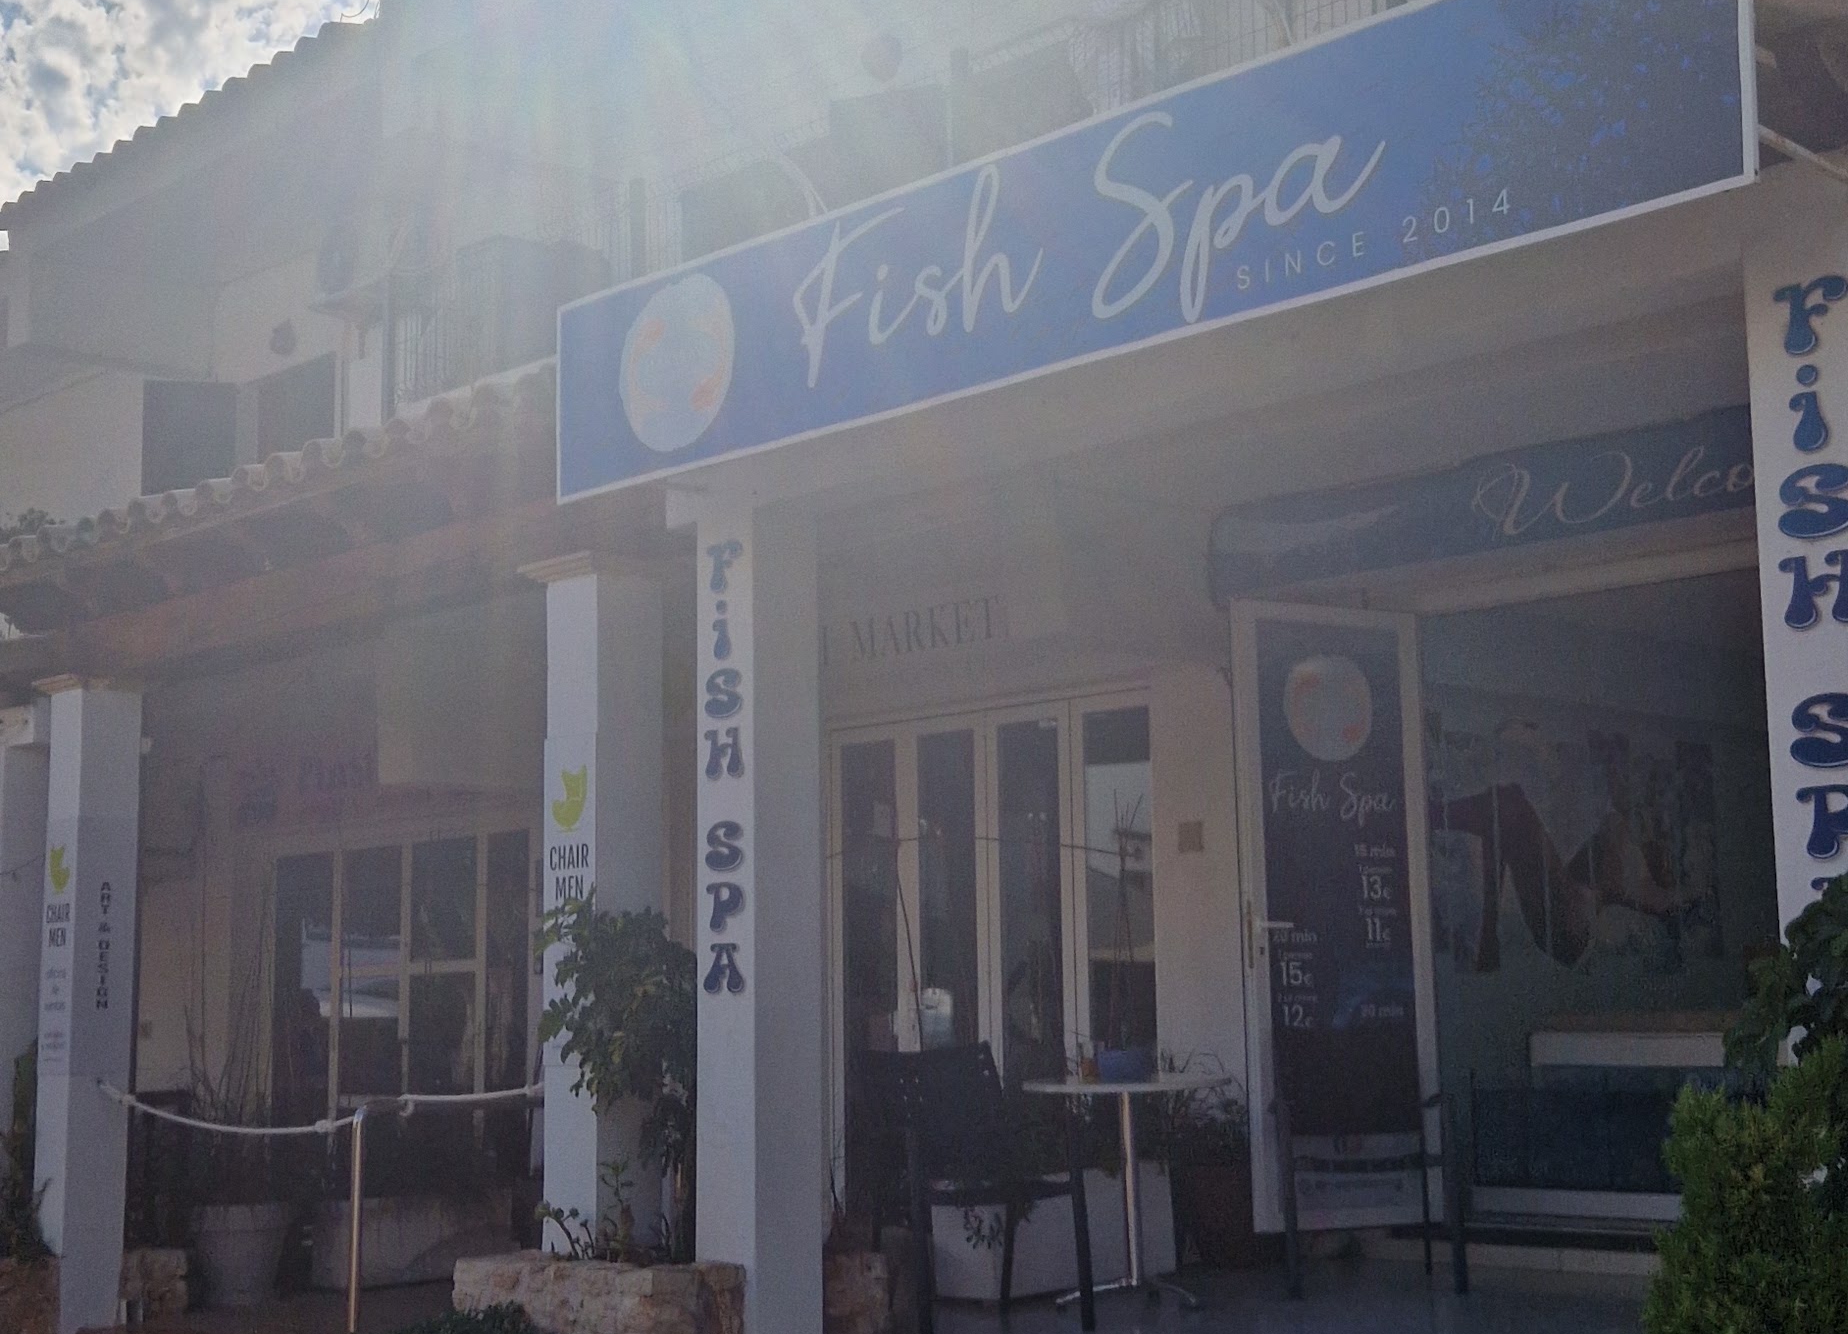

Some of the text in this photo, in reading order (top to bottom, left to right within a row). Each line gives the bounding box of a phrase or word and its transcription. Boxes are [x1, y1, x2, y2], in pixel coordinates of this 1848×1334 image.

[793, 111, 1386, 388] Fish Spa
[1237, 188, 1511, 290] SINCE 2014
[849, 593, 1000, 665] MARKET
[1268, 767, 1397, 828] Fish Spa
[1790, 691, 1848, 891] SP
[549, 843, 589, 872] CHAIR
[555, 874, 584, 902] MEN
[46, 903, 70, 924] CHAIR
[100, 881, 111, 915] ART
[703, 820, 745, 995] SPA
[48, 927, 67, 947] MEN
[96, 939, 110, 1010] DESIGN
